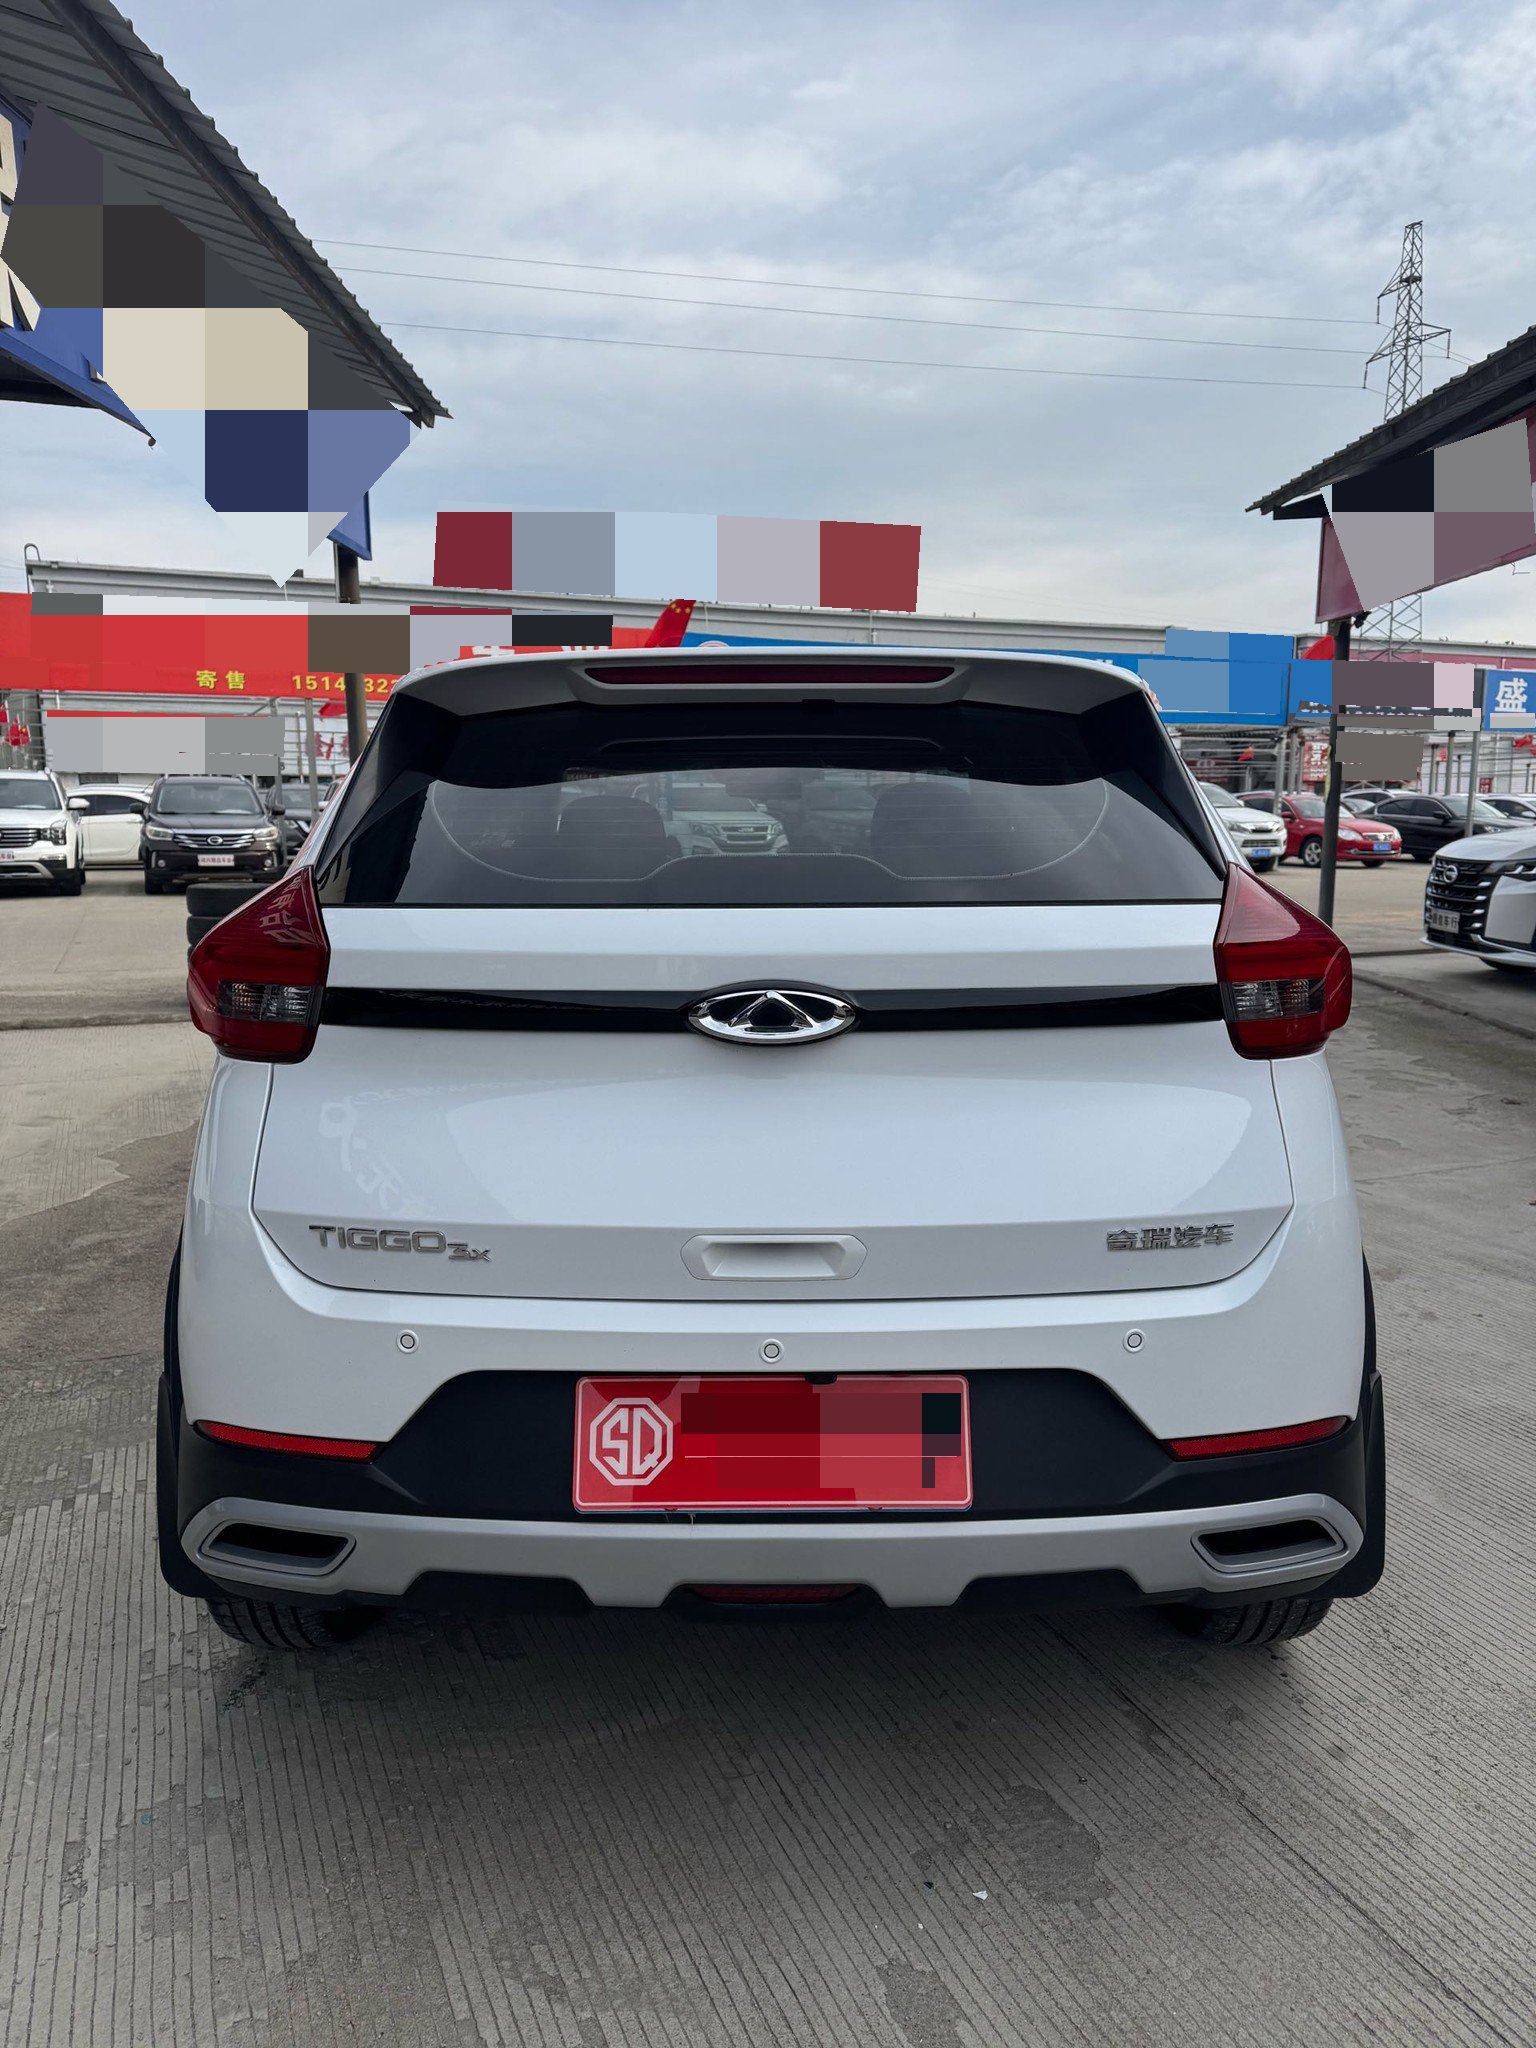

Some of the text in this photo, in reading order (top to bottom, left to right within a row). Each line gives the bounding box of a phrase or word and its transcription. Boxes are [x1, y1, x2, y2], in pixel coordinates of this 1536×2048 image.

[196, 670, 245, 690] 寄售
[1494, 677, 1528, 713] 盛
[309, 1225, 446, 1254] TIGGO
[1106, 1222, 1235, 1252] 奇瑞汽车
